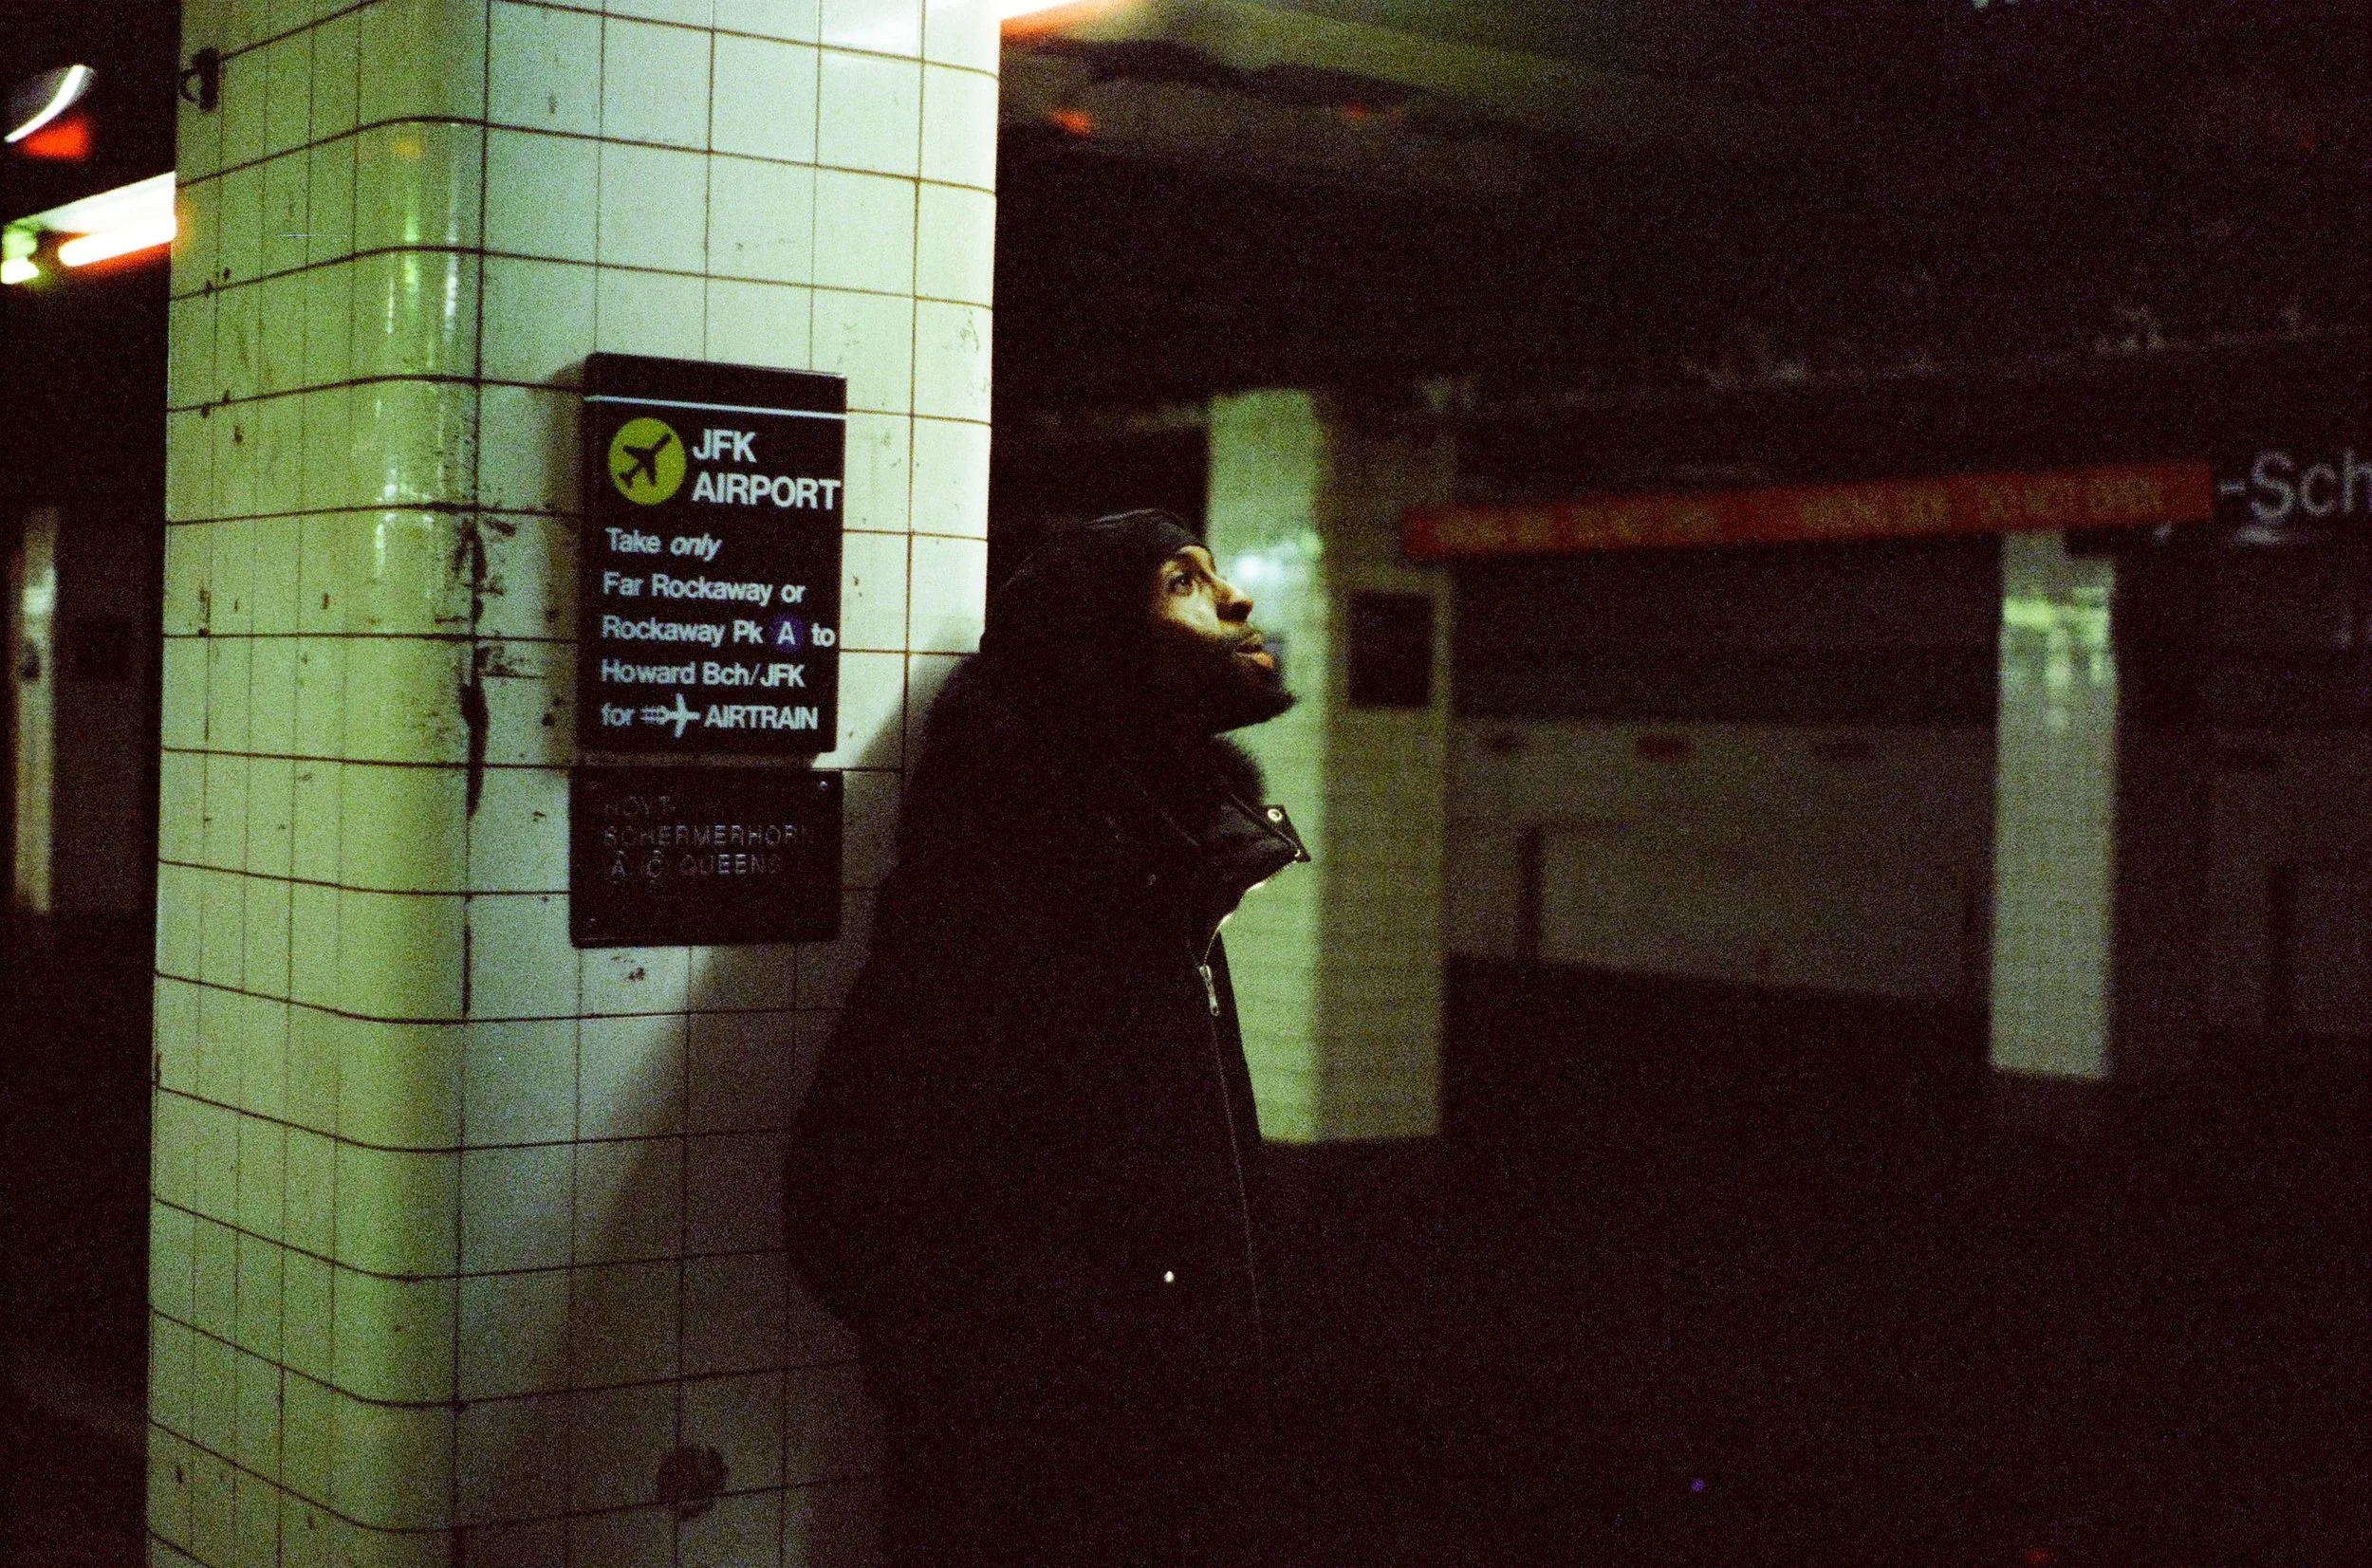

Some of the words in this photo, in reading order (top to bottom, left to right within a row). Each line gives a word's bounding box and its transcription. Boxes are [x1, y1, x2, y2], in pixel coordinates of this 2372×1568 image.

[693, 429, 756, 463] JFK
[692, 471, 841, 510] AIRPORT
[605, 527, 661, 553] Take
[670, 532, 723, 562] only
[602, 571, 643, 597] Far
[652, 573, 773, 607] Rockaway
[781, 583, 806, 603] or
[602, 615, 725, 648] Rockaway
[732, 619, 764, 645] Pk
[776, 621, 796, 645] A
[811, 622, 836, 647] to
[602, 657, 695, 685] Howard
[703, 661, 806, 688] Bch/JFK
[602, 702, 635, 727] for
[704, 705, 818, 729] AIRTRAIN
[679, 853, 782, 876] QUEENS
